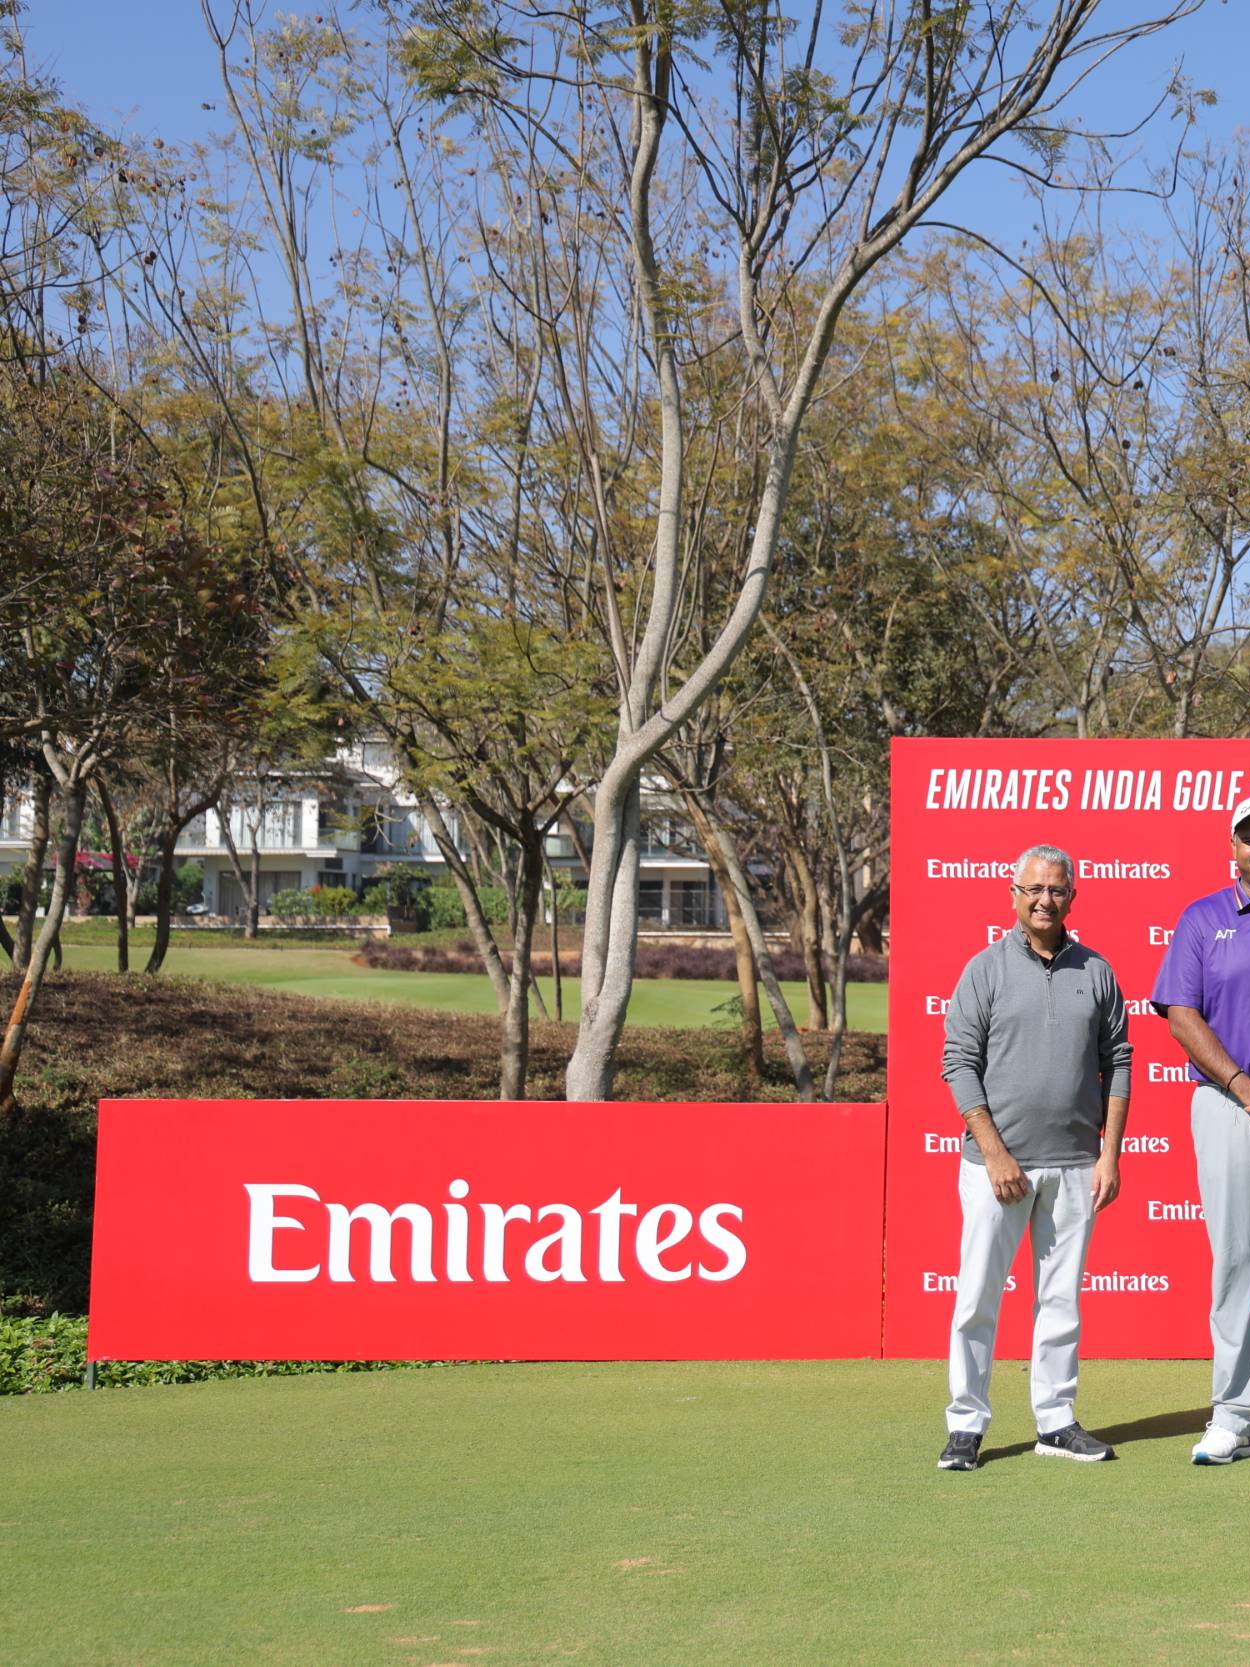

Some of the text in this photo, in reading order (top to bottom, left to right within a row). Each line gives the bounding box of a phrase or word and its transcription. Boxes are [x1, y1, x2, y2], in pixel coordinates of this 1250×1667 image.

[925, 768, 1073, 811] EMIRATES
[1080, 768, 1162, 812] INDIA
[1173, 769, 1246, 812] GOLF
[1078, 858, 1171, 880] Emirates
[1100, 1132, 1170, 1153] rates
[1147, 1199, 1206, 1220] Emir
[243, 1178, 747, 1283] Emirates
